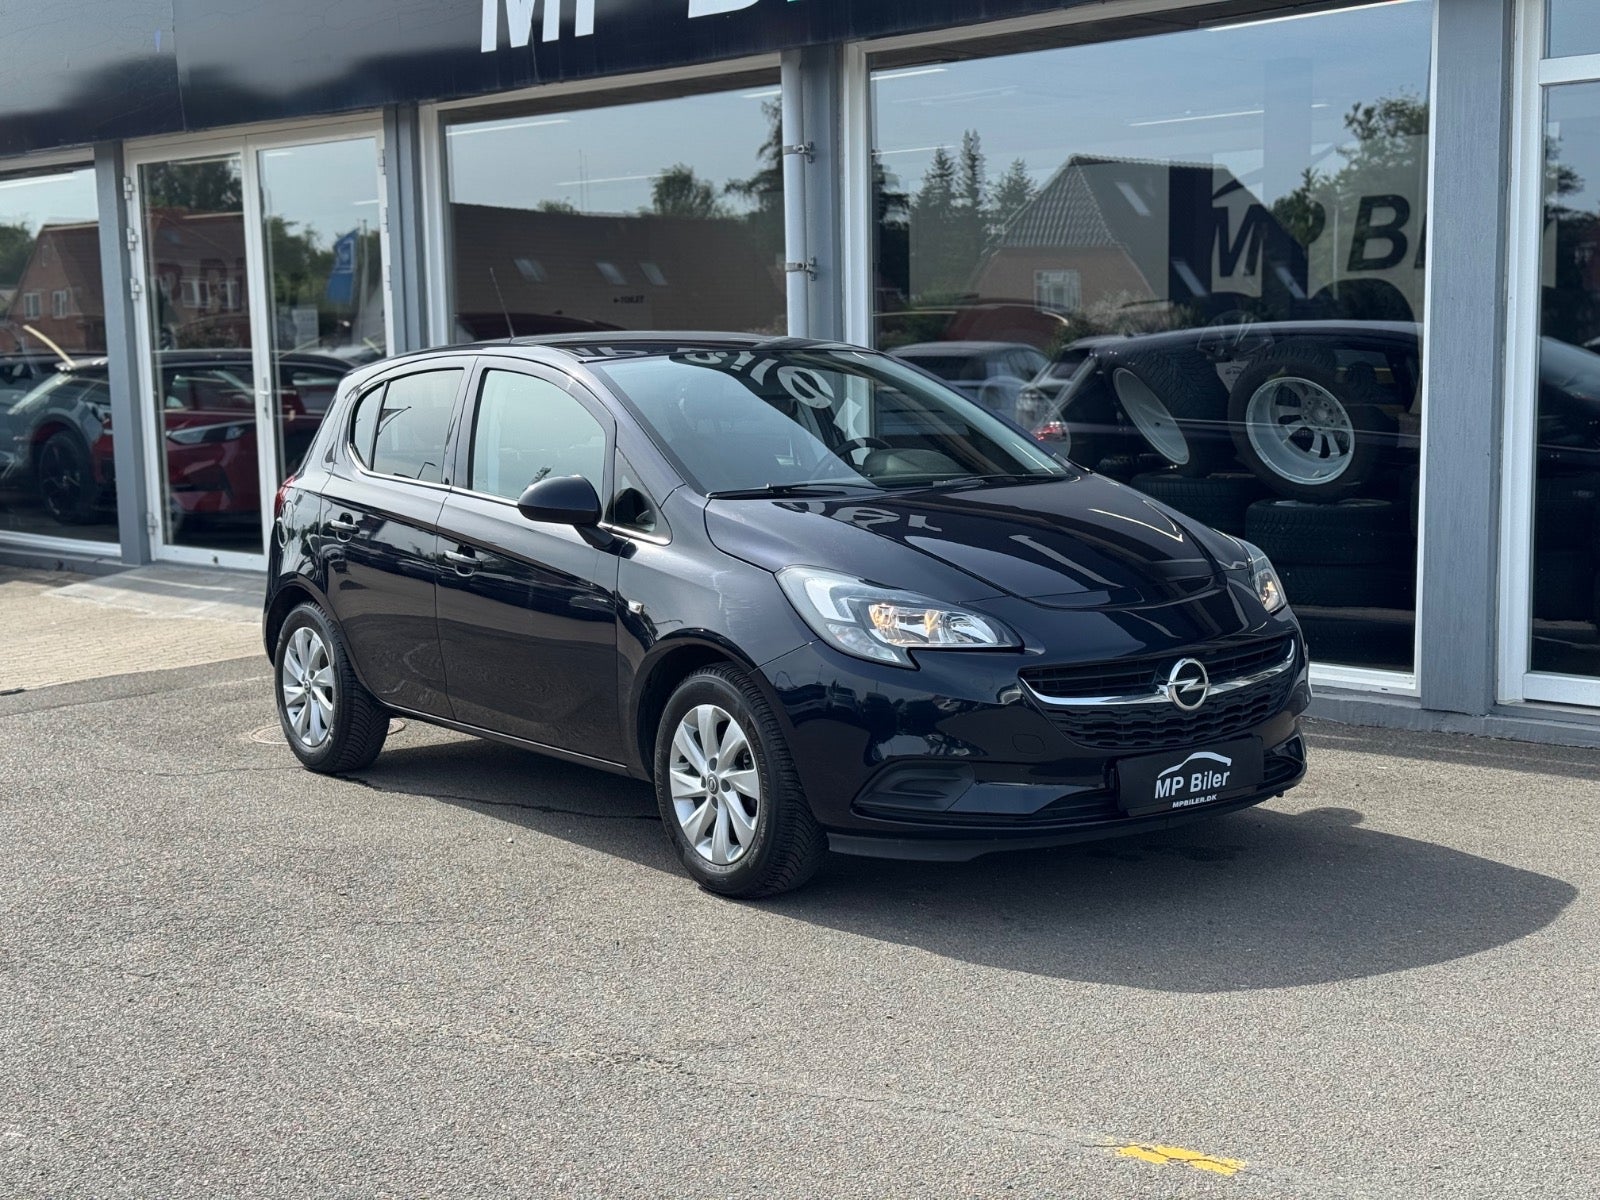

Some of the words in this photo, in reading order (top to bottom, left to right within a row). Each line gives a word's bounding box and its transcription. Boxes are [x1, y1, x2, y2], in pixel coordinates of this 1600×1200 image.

[1154, 776, 1185, 799] MP
[1189, 770, 1231, 793] Biler
[1172, 794, 1218, 809] MPBILER.DK
